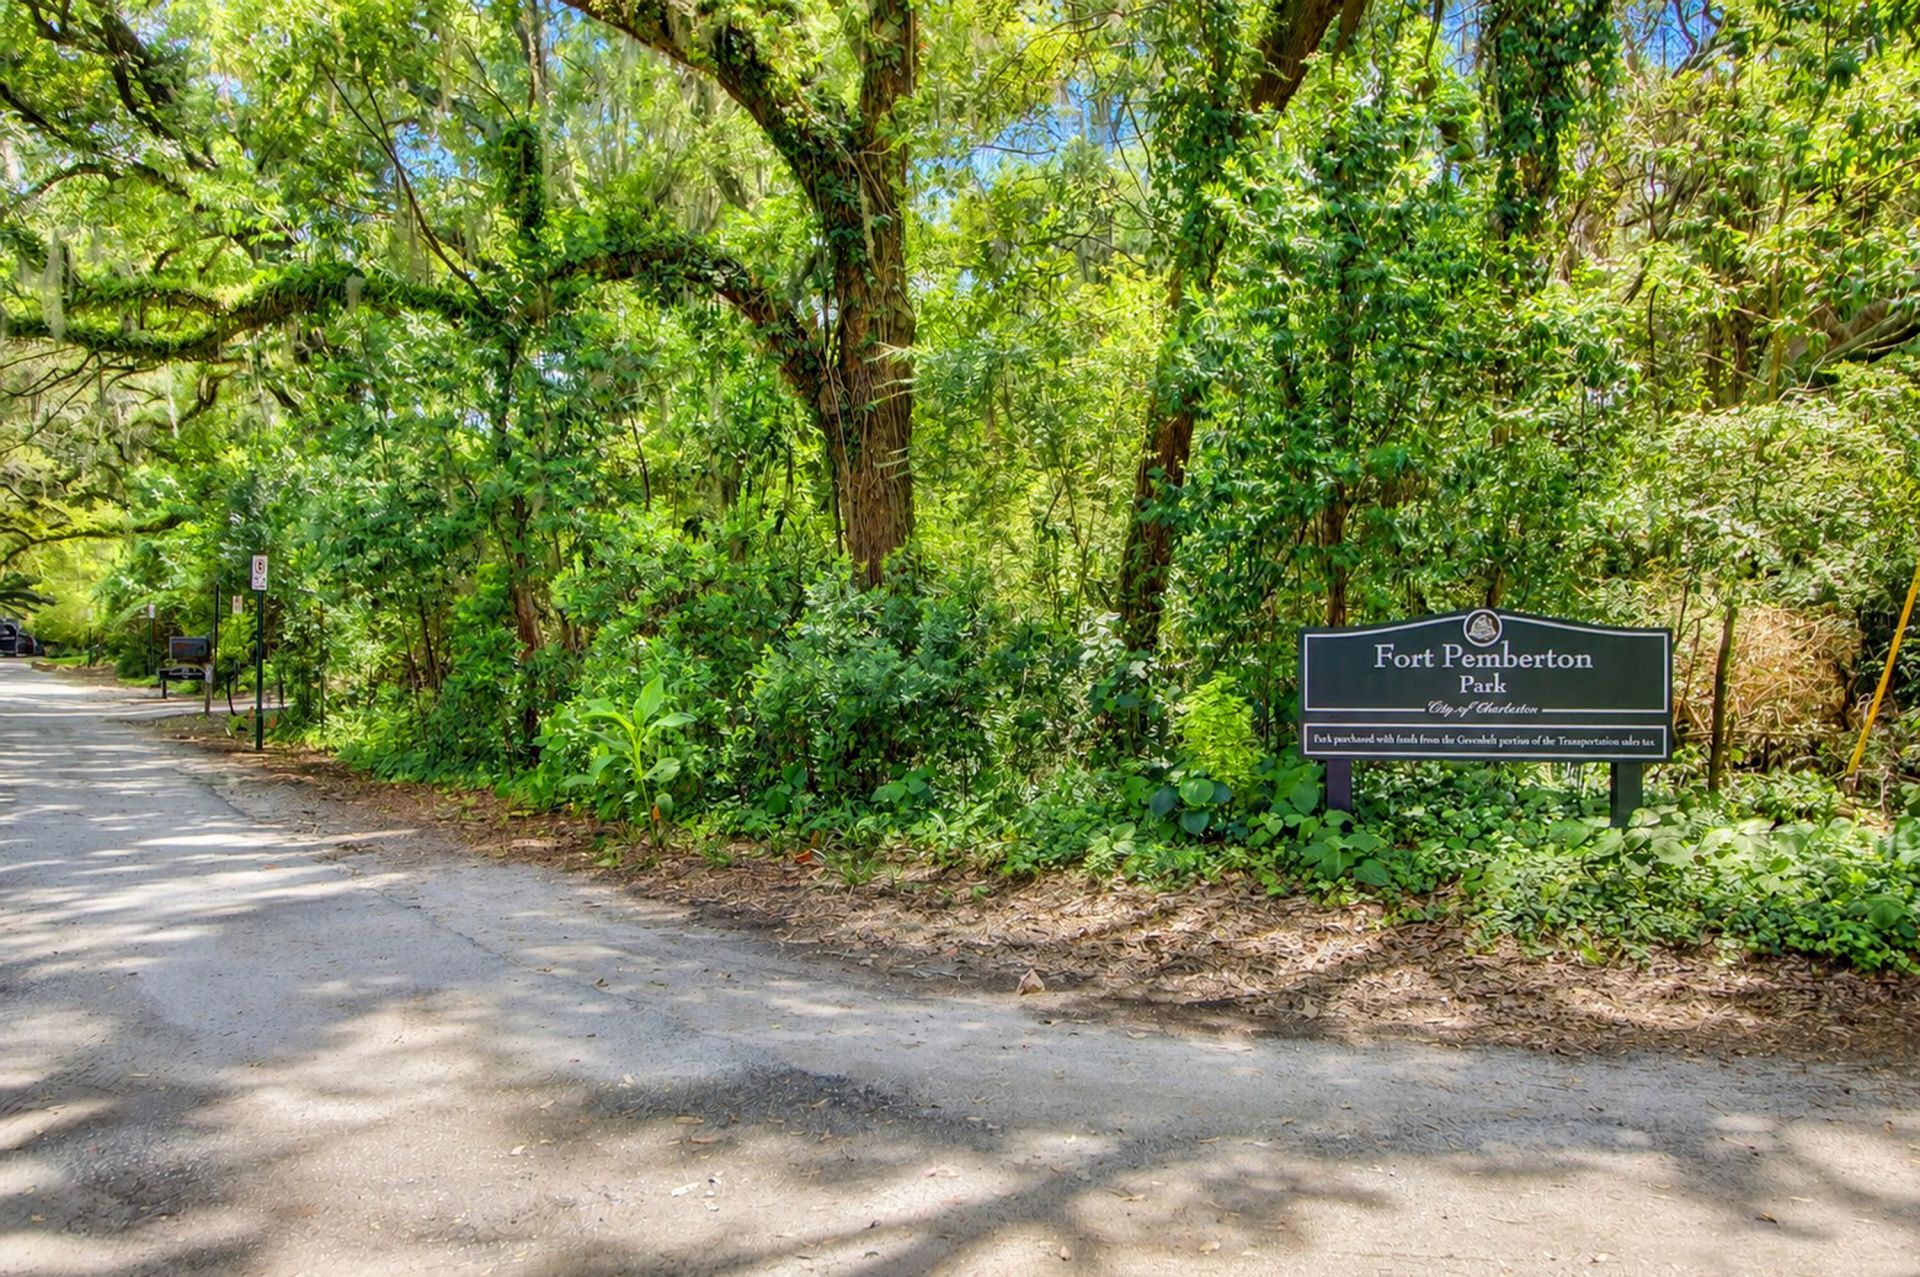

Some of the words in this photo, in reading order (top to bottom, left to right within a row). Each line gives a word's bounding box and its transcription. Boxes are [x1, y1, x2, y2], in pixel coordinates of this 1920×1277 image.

[1374, 643, 1435, 668] Fort
[1442, 640, 1593, 668] Pemberton
[1459, 672, 1507, 694] Park
[1428, 700, 1454, 718] City
[1455, 701, 1479, 718] of
[1476, 702, 1538, 714] Charleston
[1313, 733, 1332, 743] Park
[1334, 733, 1375, 746] purchased
[1376, 733, 1394, 744] with
[1396, 733, 1418, 744] funds
[1420, 733, 1440, 744] from
[1442, 734, 1455, 744] the
[1499, 734, 1530, 748] portion
[1531, 734, 1542, 745] of
[1542, 734, 1556, 746] the
[1558, 735, 1620, 748] Transportation
[1621, 734, 1640, 746] sales
